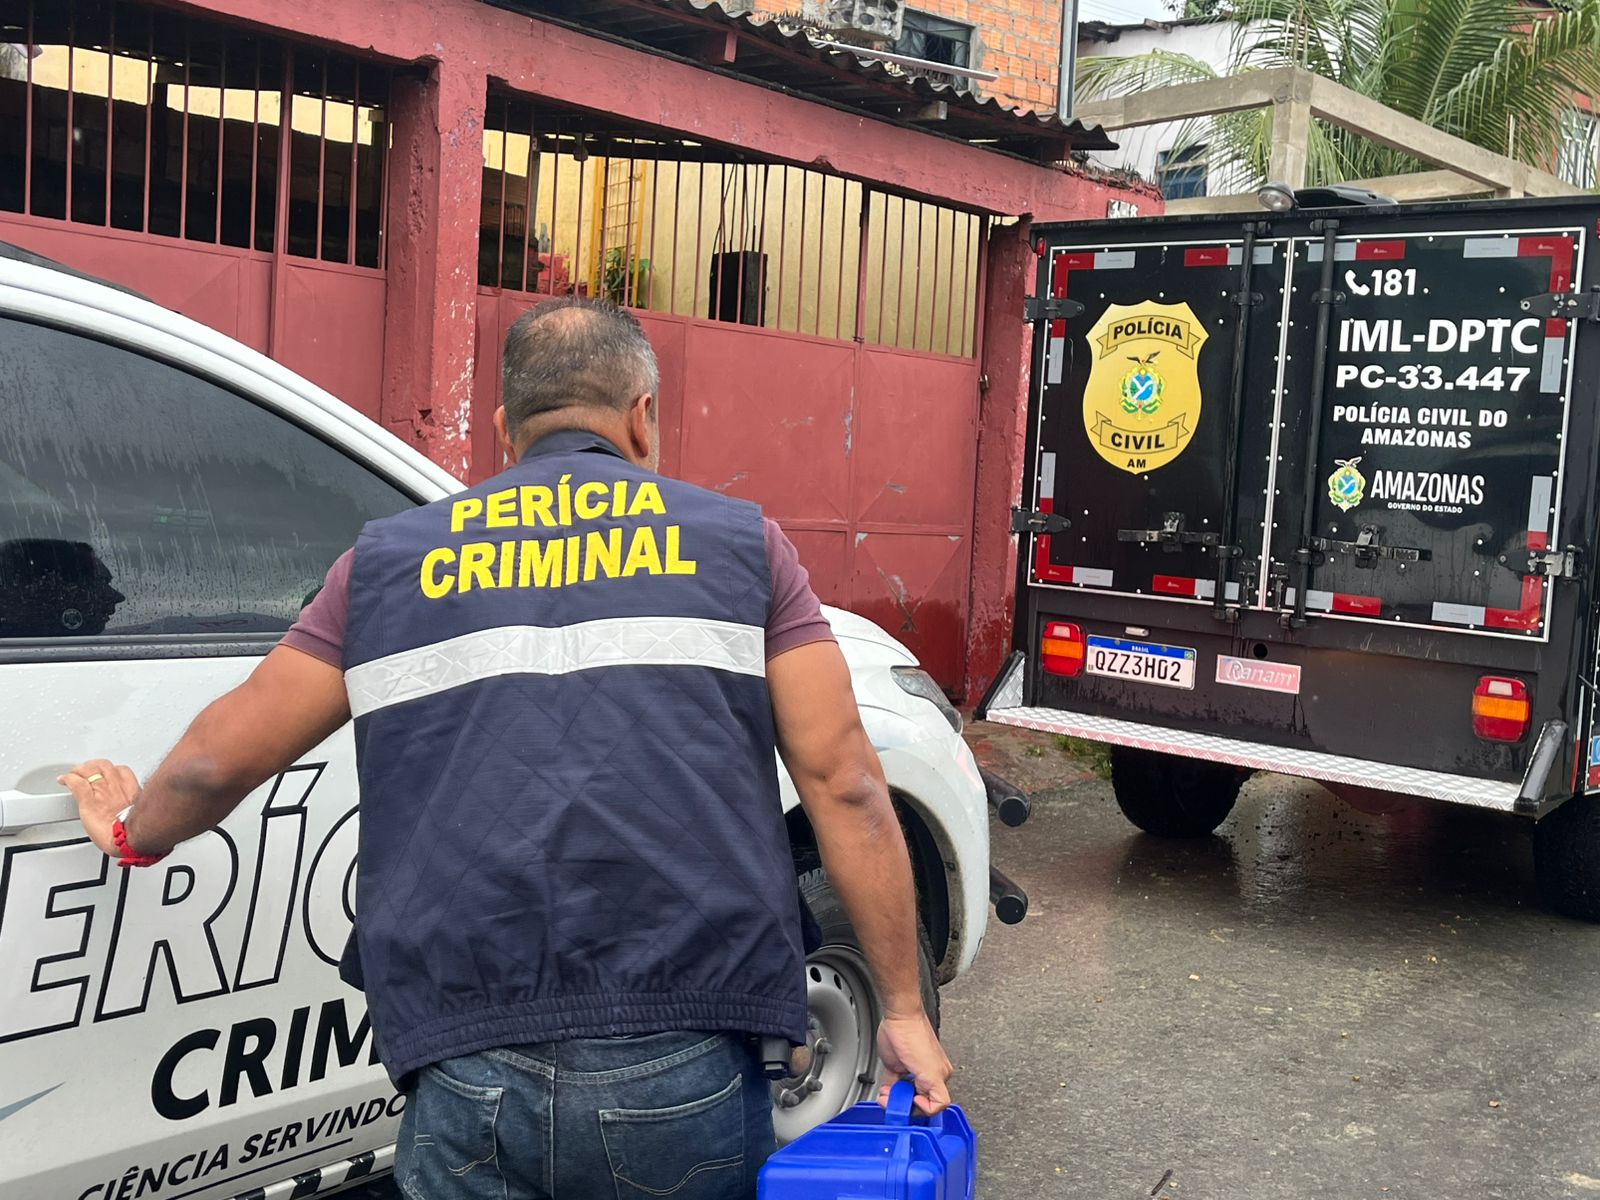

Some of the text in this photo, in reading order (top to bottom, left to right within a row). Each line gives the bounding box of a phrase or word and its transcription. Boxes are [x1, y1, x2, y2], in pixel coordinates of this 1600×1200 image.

[1371, 268, 1417, 296] 181
[1113, 317, 1183, 340] POLÍCIA
[1339, 318, 1541, 354] IML-DPTC
[1336, 364, 1531, 392] PC-33.447
[1333, 401, 1508, 428] POLÍCIA CIVIL DO
[1111, 432, 1165, 450] CIVIL
[1361, 428, 1472, 449] AMAZONAS
[1127, 458, 1146, 468] AM
[1370, 470, 1485, 505] AMAZONAS
[451, 474, 666, 532] PERÍCIA
[1387, 502, 1421, 511] GOVERNO
[1434, 505, 1463, 514] ESTADO
[420, 525, 696, 599] CRIMINAL
[1095, 650, 1182, 683] QZZ3H02
[238, 1093, 408, 1164] SERVINDO
